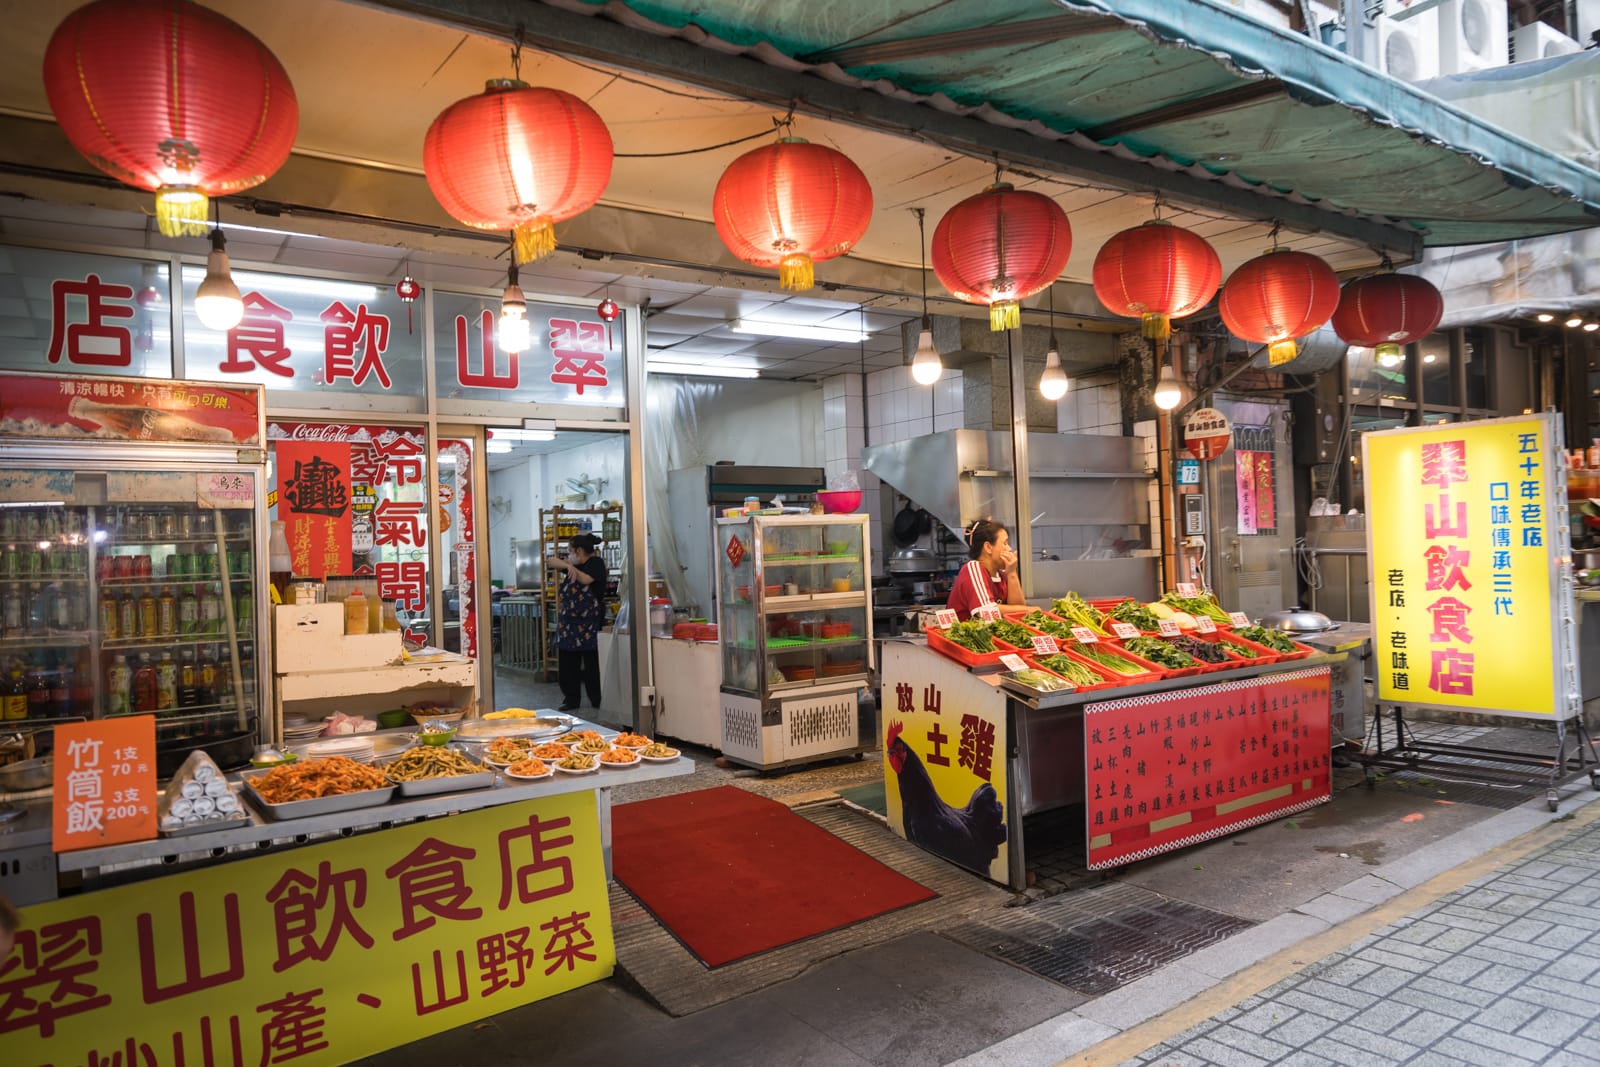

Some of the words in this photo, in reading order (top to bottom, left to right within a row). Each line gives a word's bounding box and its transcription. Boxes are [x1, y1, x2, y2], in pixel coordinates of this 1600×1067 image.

[291, 423, 351, 442] Coca-Cola
[1186, 467, 1196, 481] 76
[1518, 433, 1544, 547] 五十年老店
[371, 436, 427, 648] 冷氣開
[1421, 440, 1474, 697] 翠山飲食店
[1489, 481, 1514, 616] 口味傳承三代
[66, 737, 104, 834] 竹筒飯
[111, 763, 132, 777] 70
[112, 788, 140, 803] 3支
[113, 746, 138, 761] 1支
[1107, 726, 1119, 822] 三杯土雞
[106, 805, 137, 820] 200
[0, 814, 576, 1040] 翠山飲食店
